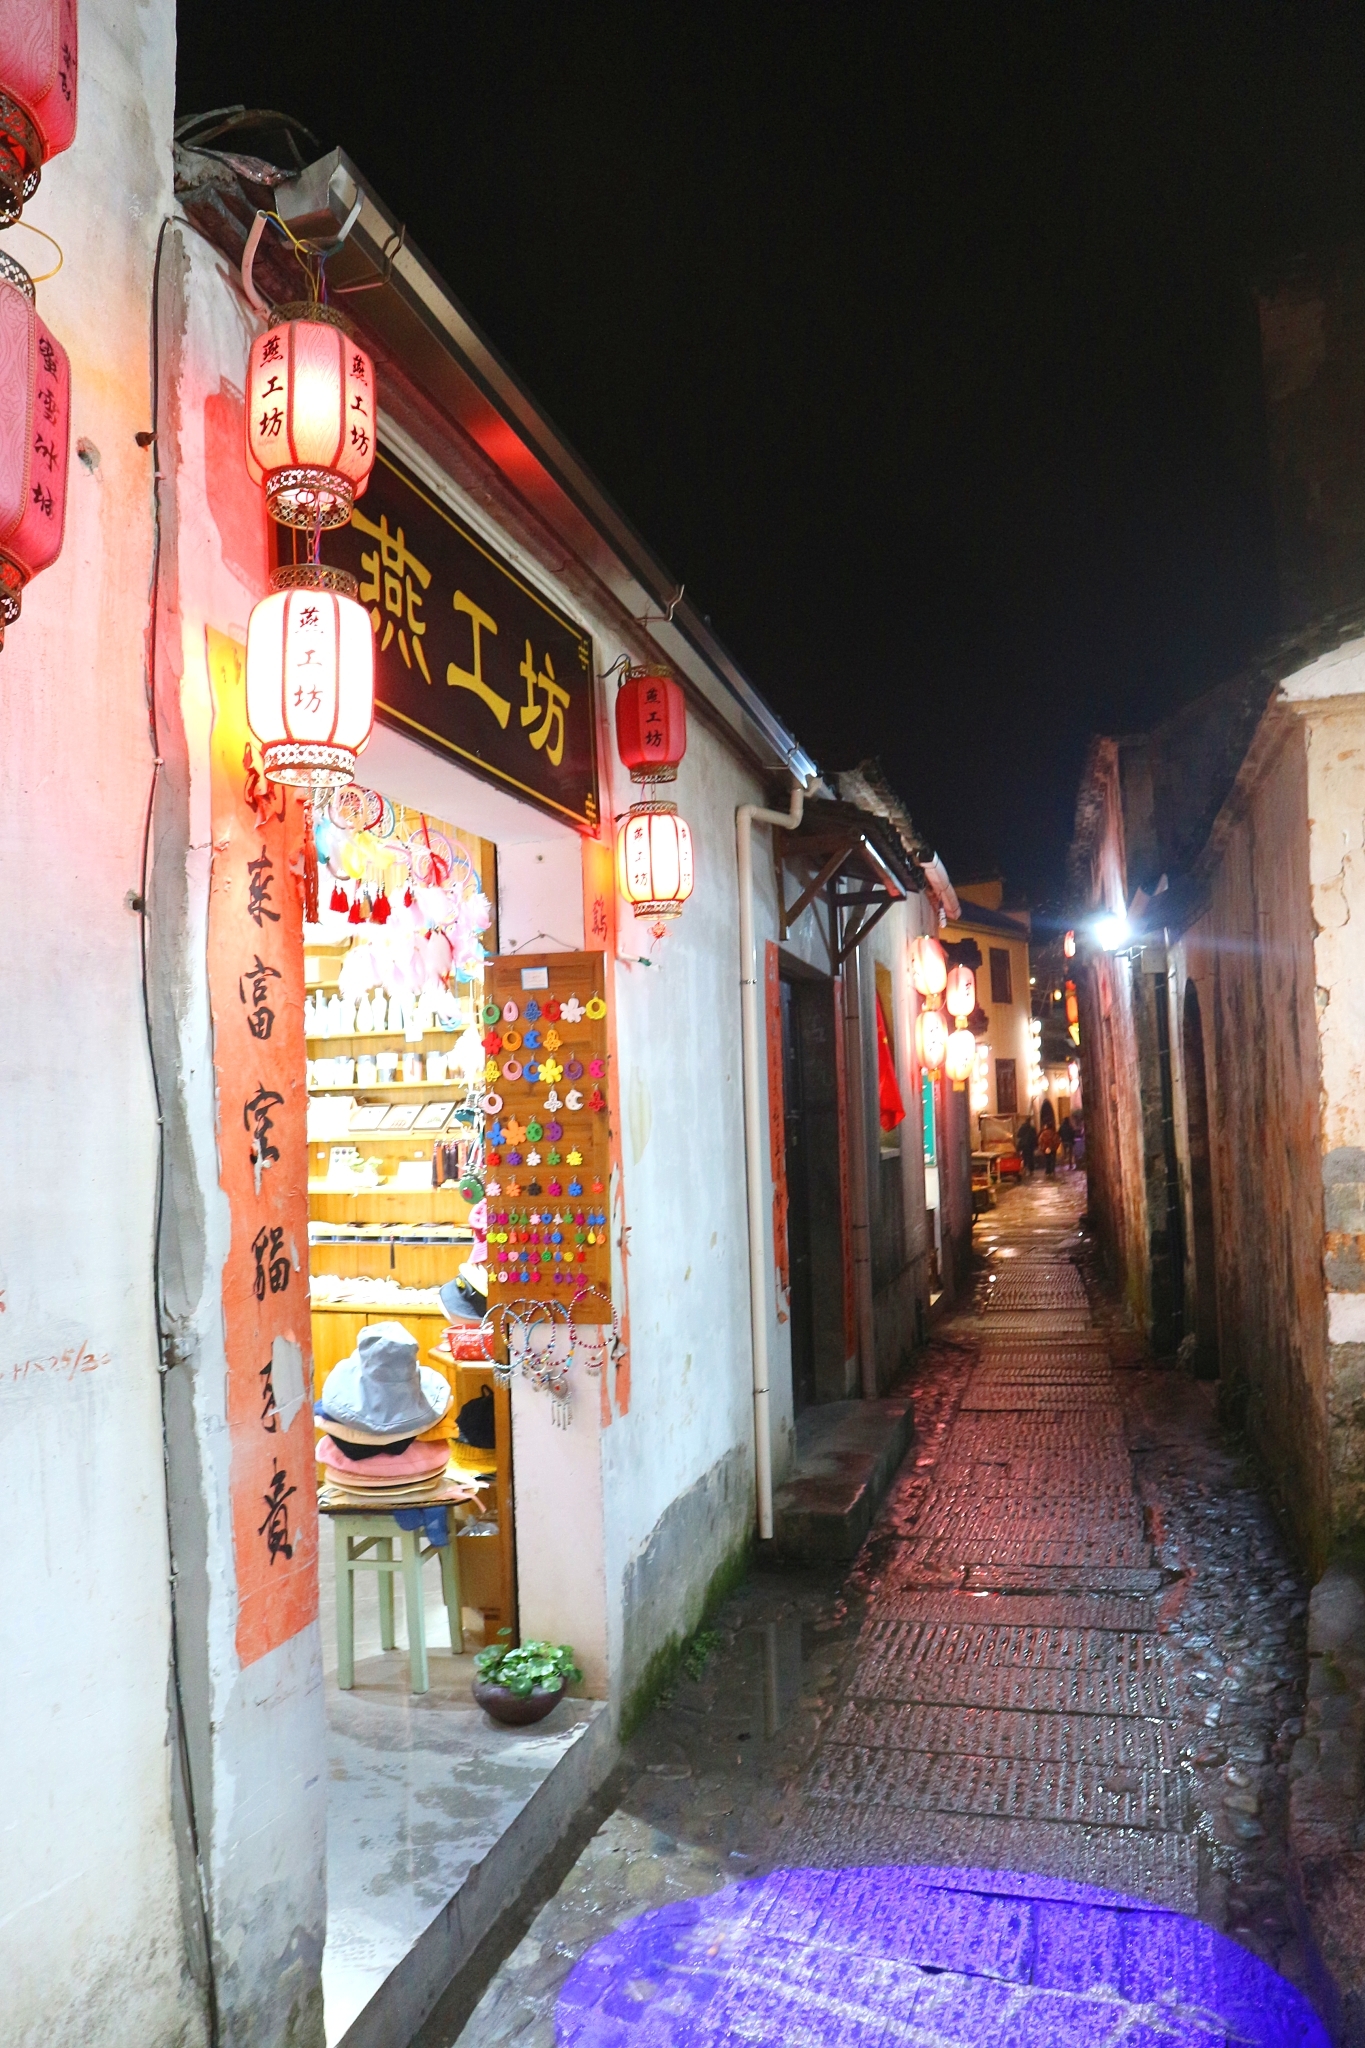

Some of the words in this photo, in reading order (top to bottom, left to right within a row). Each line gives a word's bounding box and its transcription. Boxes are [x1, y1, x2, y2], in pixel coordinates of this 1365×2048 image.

[259, 335, 284, 438] 燕工坊
[350, 354, 371, 457] 燕工坊
[294, 606, 324, 713] 燕工坊
[351, 508, 571, 767] 燕工坊
[644, 687, 663, 747] 燕工坊
